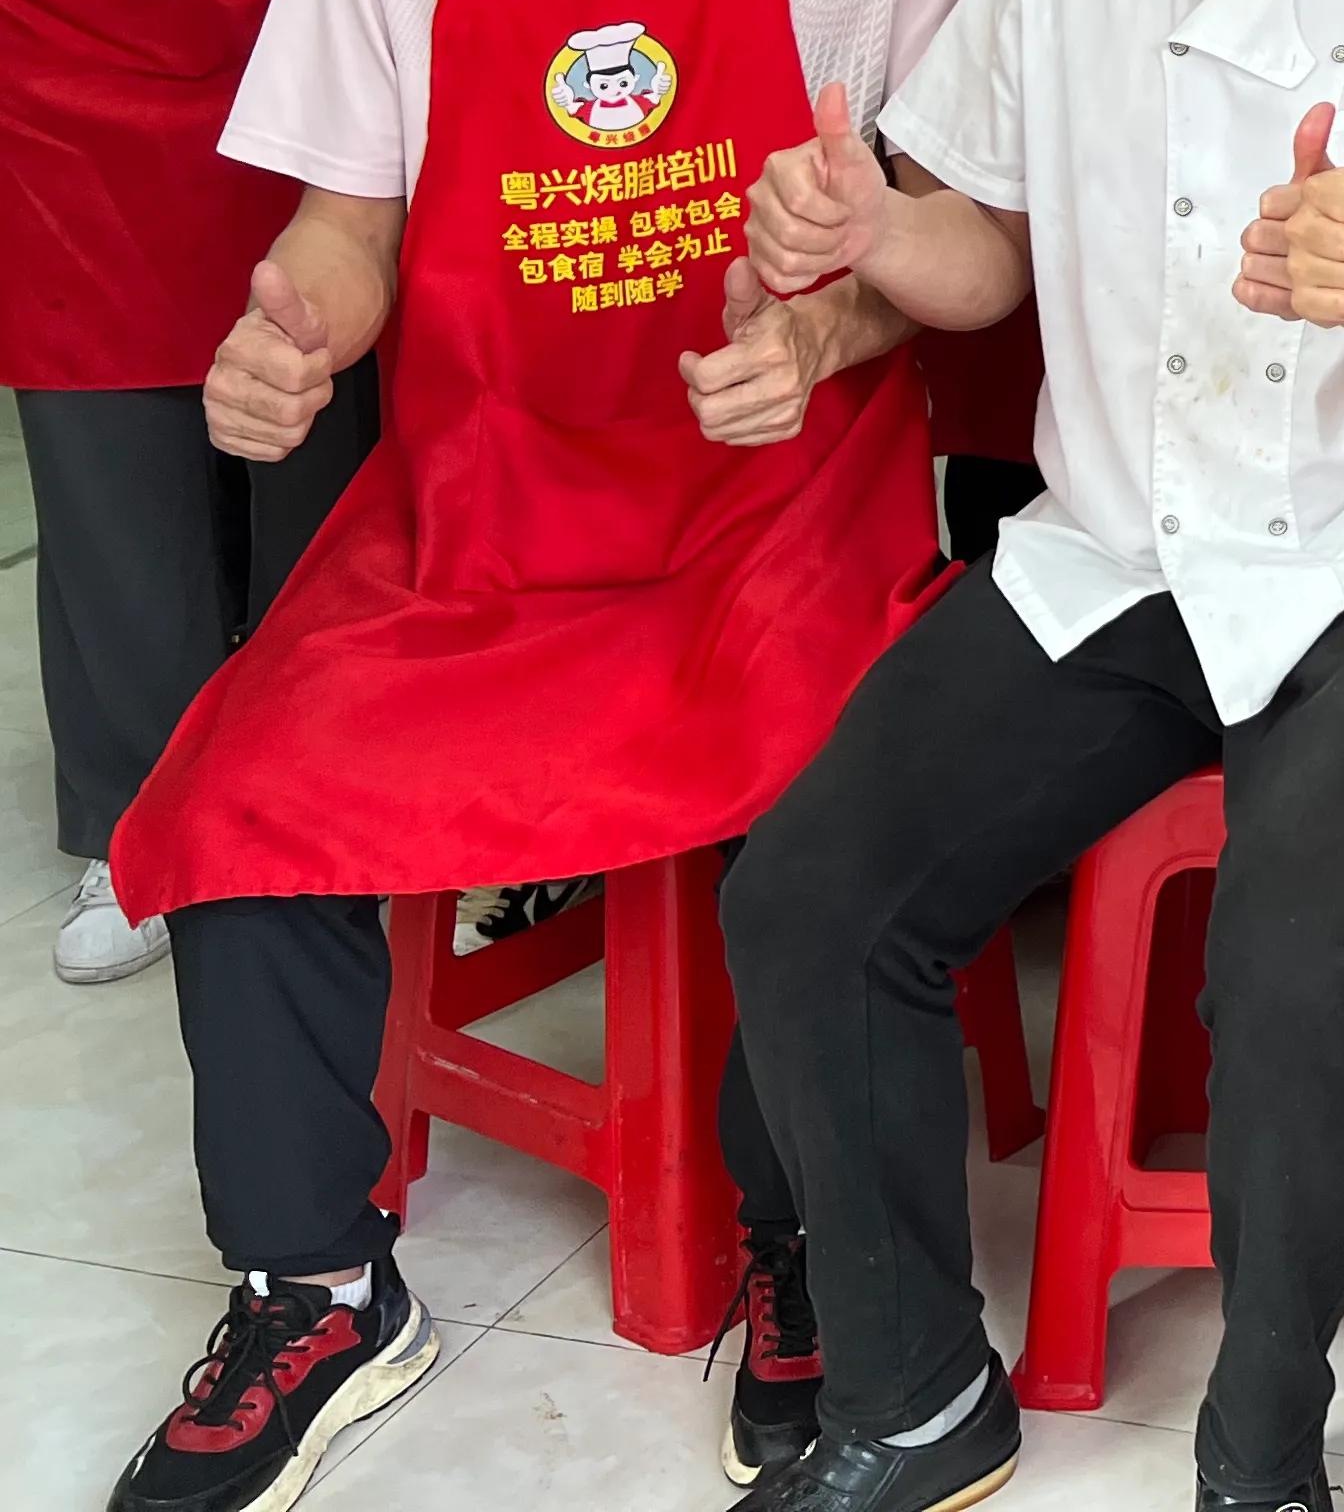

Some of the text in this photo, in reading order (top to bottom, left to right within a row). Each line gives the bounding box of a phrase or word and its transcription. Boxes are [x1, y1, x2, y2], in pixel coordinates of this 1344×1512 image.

[500, 138, 737, 211] 粤兴烧腊培训
[501, 191, 742, 252] 全程实操 包教包会
[518, 227, 733, 285] 包食宿 学会为止
[571, 269, 684, 314] 随到随学
